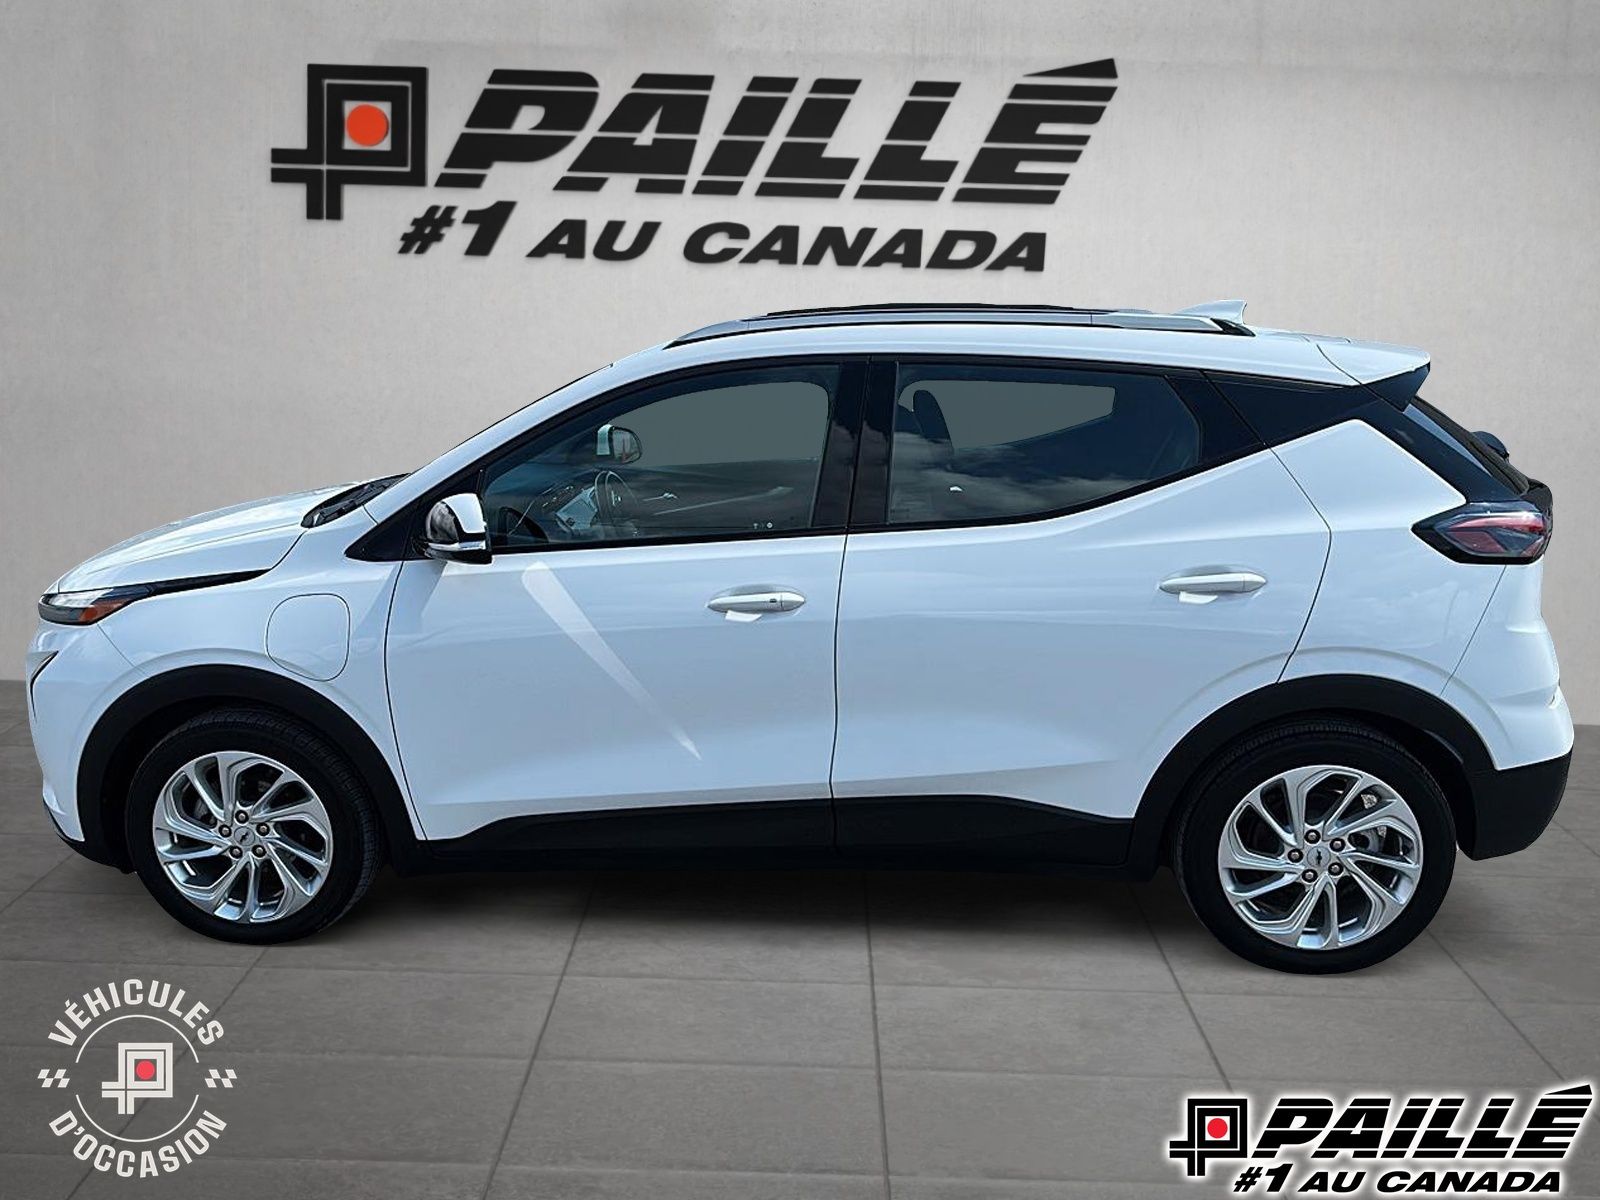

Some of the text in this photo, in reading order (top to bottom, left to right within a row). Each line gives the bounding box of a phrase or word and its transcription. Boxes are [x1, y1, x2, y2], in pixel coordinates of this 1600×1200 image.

[433, 58, 1118, 205] PAILLÉ
[398, 200, 1047, 272] #1 AU CANADA
